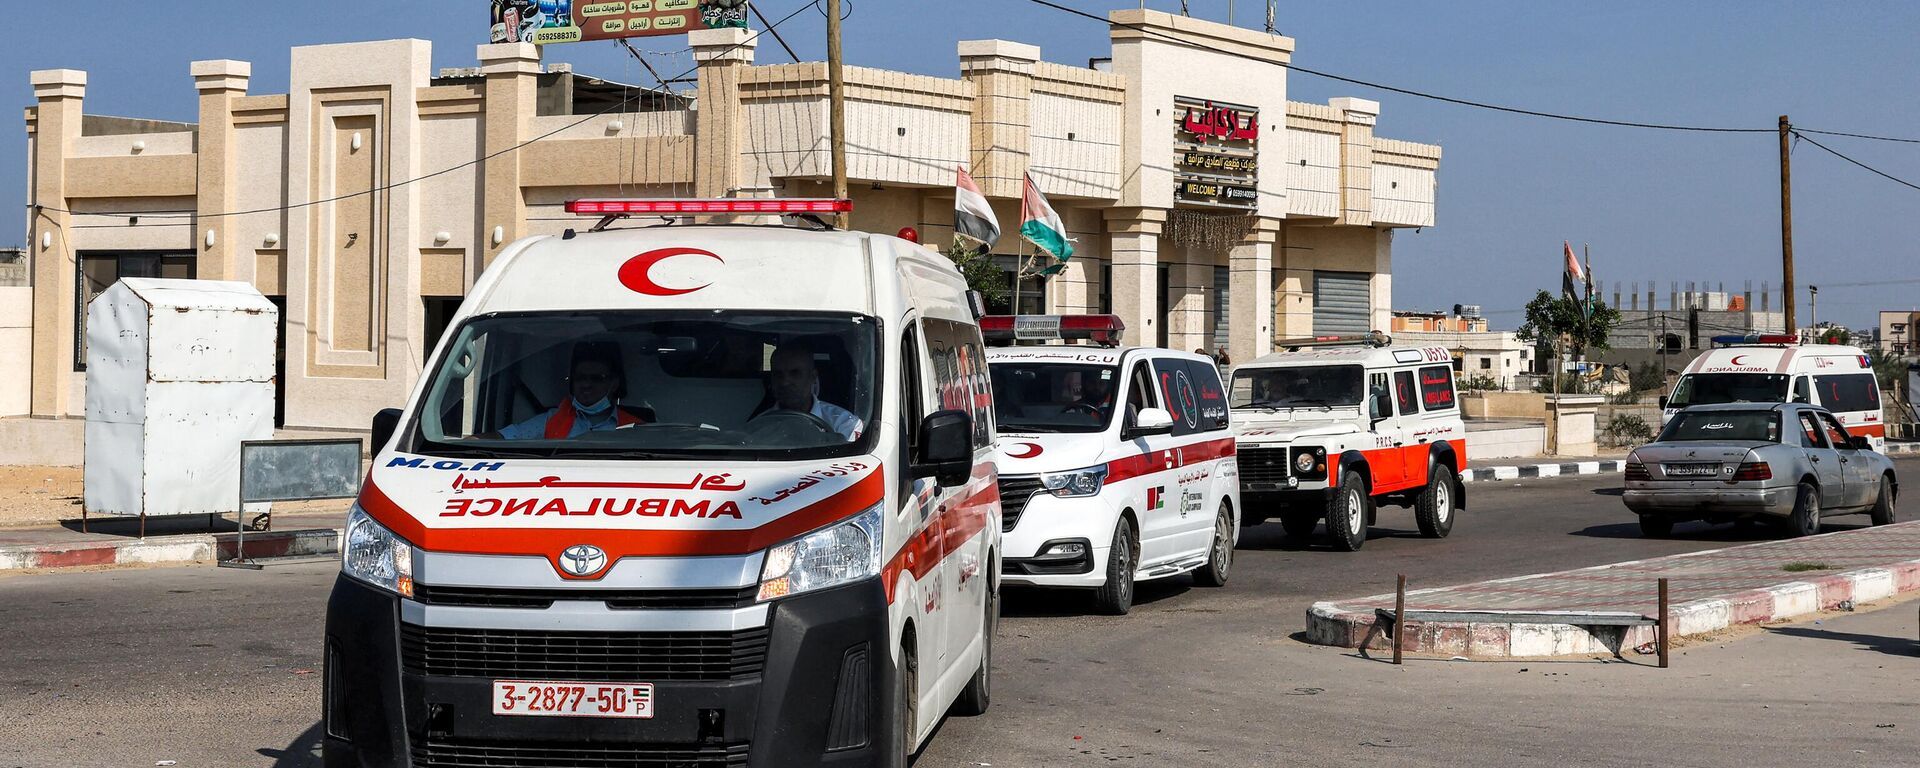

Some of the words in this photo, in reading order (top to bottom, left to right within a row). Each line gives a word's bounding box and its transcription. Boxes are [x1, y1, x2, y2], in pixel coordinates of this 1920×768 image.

[602, 3, 625, 12] مشروبات
[1187, 183, 1216, 196] WELCOME
[1075, 354, 1115, 363] I.C.U
[1426, 389, 1452, 404] AMBULANCE
[386, 456, 506, 472] M.O.H
[501, 685, 627, 713] 3-2877-50
[636, 702, 646, 714] P
